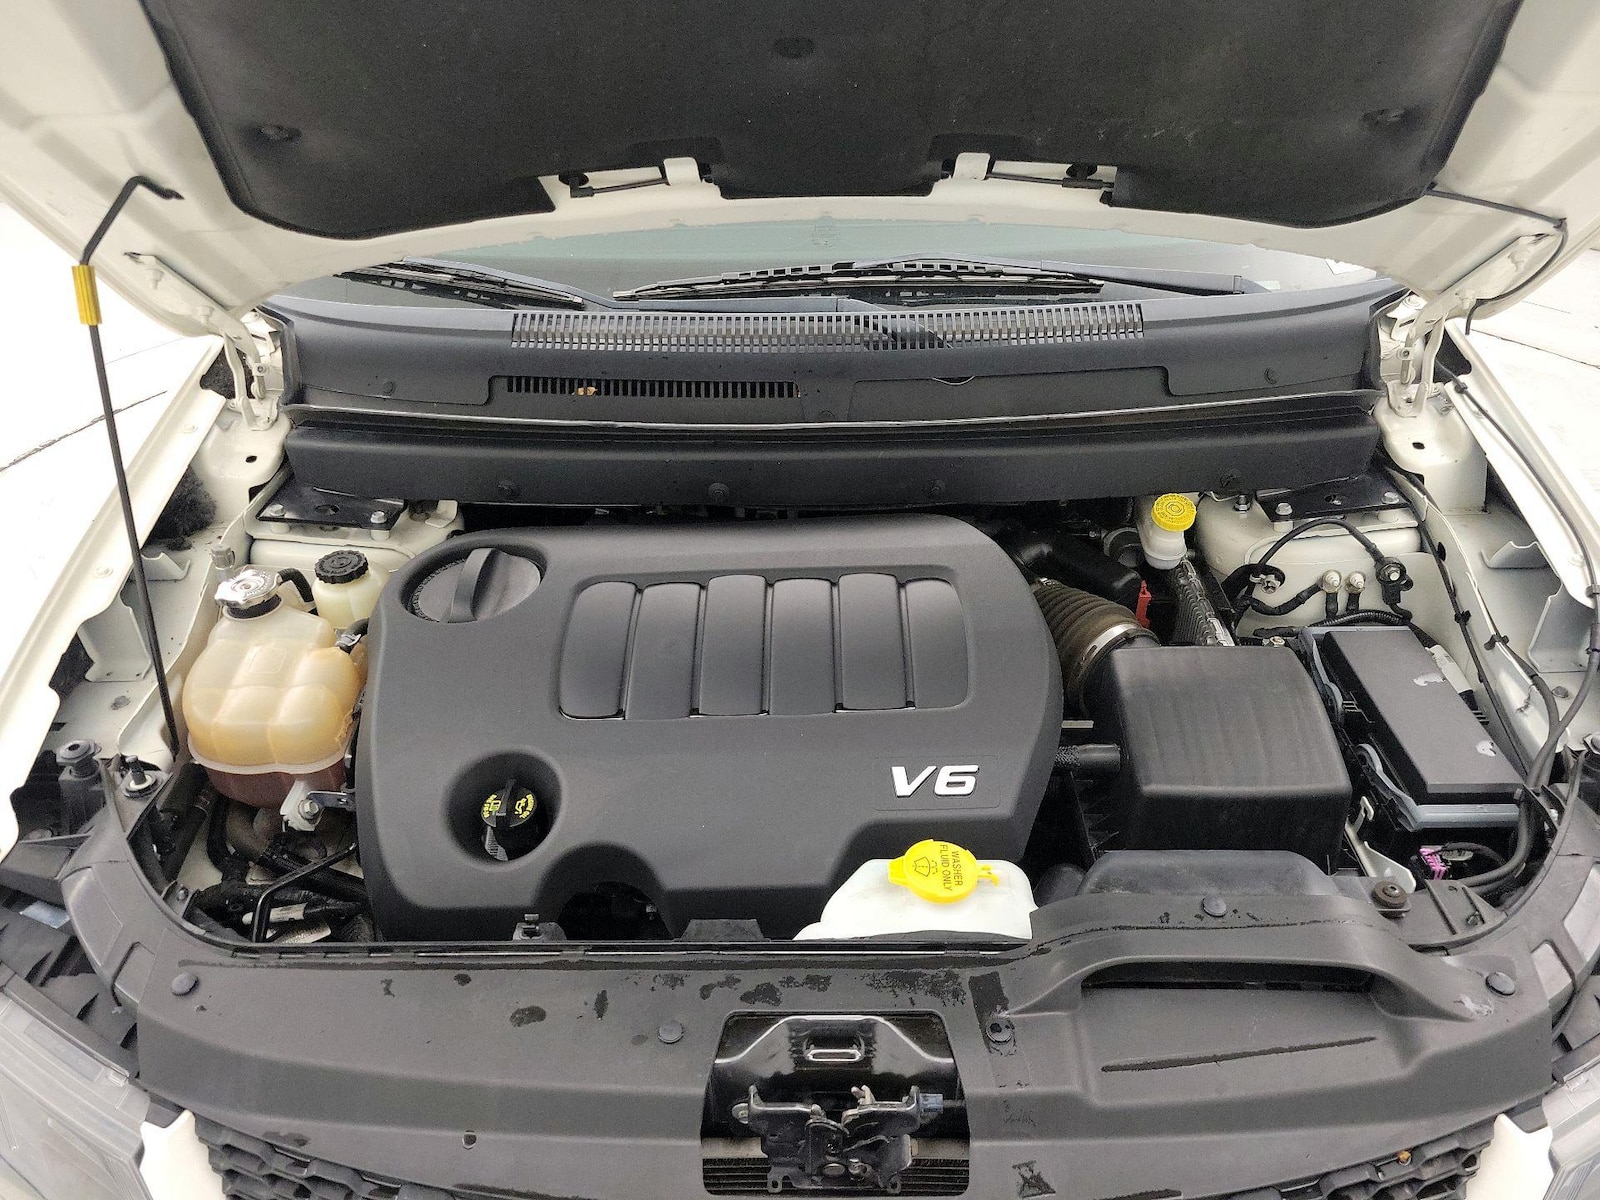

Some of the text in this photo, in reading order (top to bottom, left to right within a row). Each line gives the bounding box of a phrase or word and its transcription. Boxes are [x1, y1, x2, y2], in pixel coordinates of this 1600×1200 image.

[891, 765, 979, 798] V6
[939, 844, 953, 891] FLUID ONLY
[951, 850, 964, 886] WASHER
